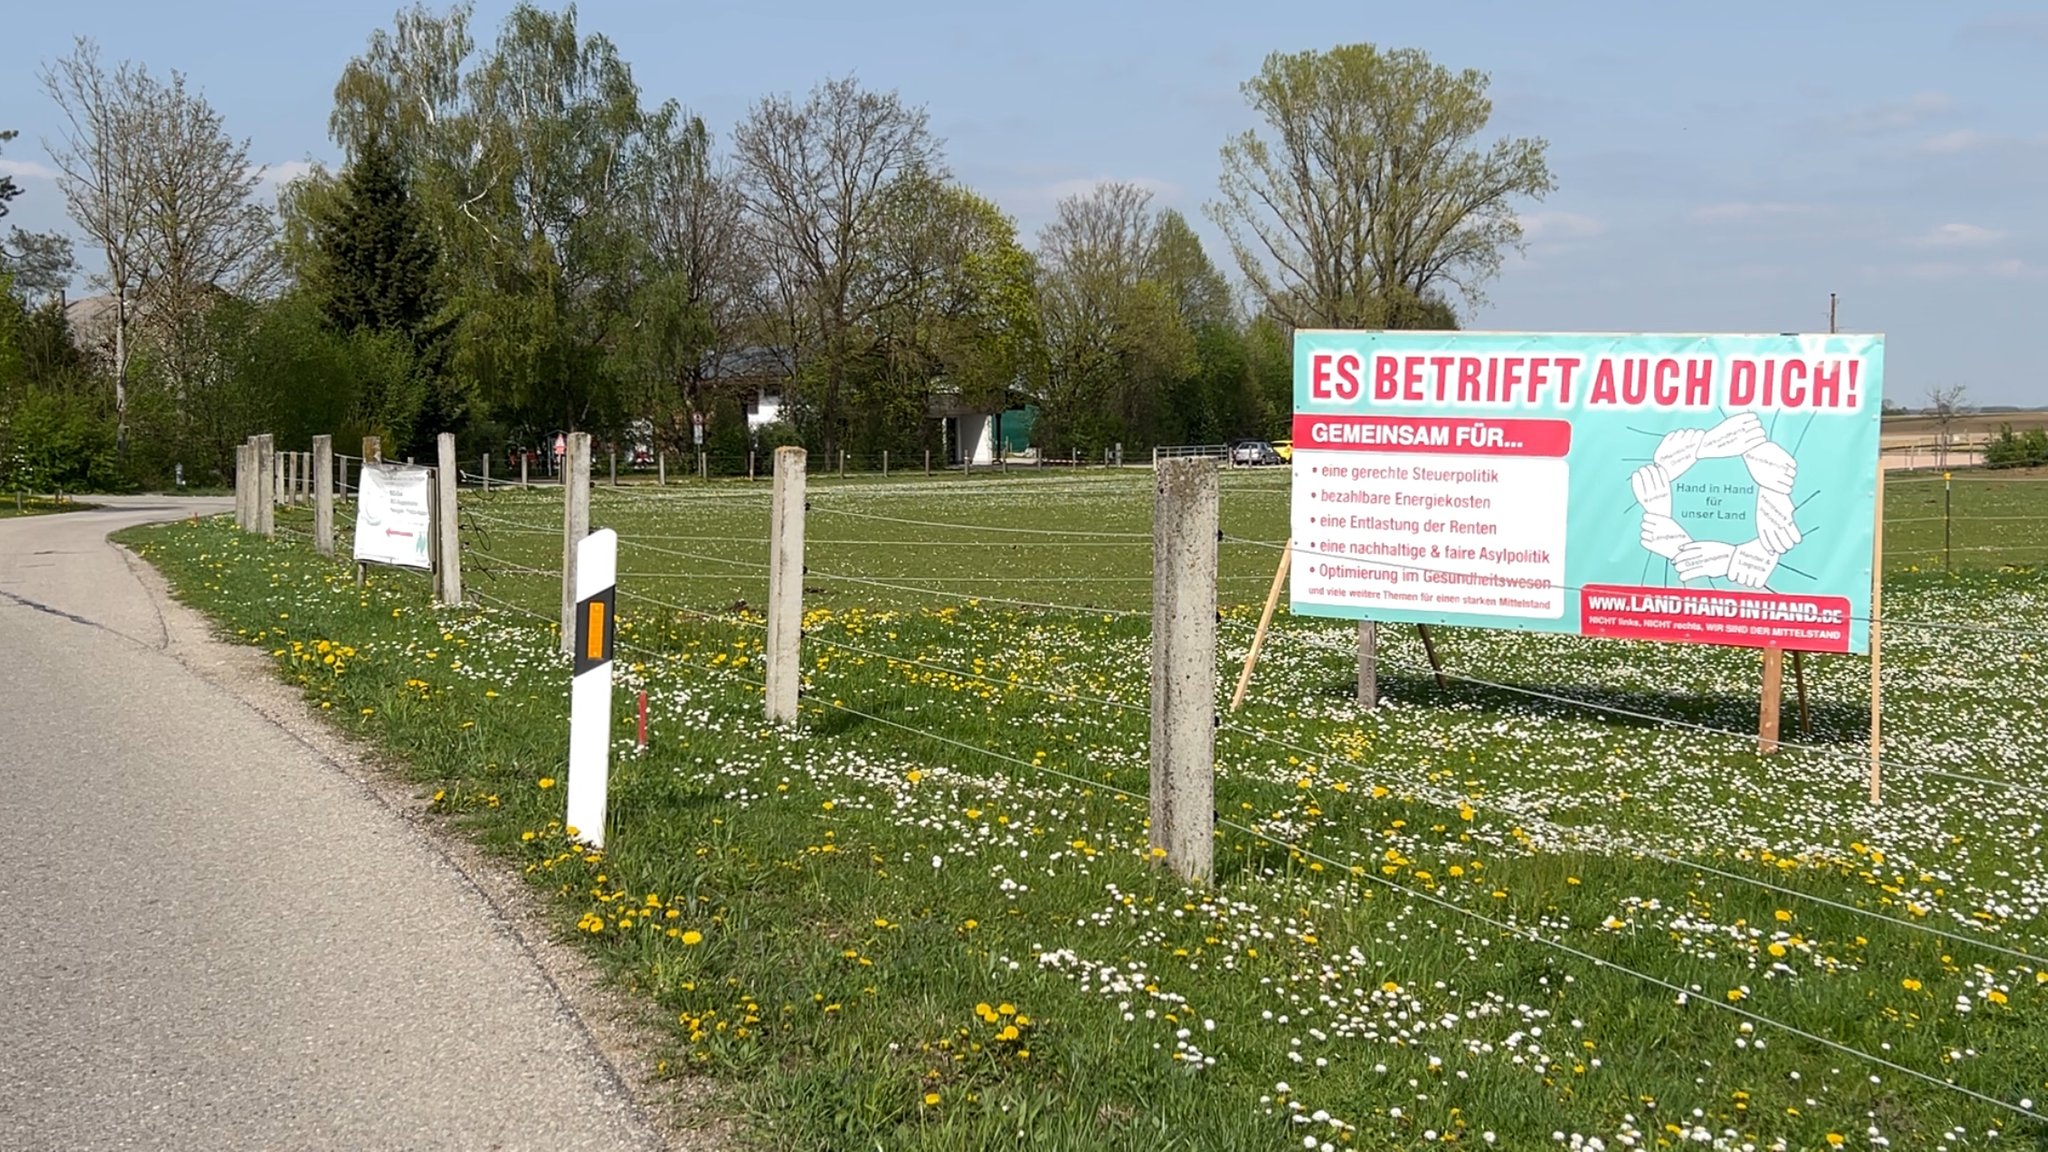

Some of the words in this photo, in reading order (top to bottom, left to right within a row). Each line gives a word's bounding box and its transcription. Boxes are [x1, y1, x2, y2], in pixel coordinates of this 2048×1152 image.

[1313, 355, 1360, 400] ES
[1374, 356, 1580, 404] BETRIFFT
[1590, 358, 1712, 406] AUCH
[1729, 359, 1859, 408] DICH!
[1312, 423, 1450, 446] GEMEINSAM
[1456, 422, 1523, 448] FÜR...
[1322, 466, 1348, 478] eine
[1351, 466, 1408, 480] gerechte
[1412, 467, 1498, 484] Steuerpolitik
[1676, 483, 1706, 493] Hand
[1709, 484, 1720, 493] in
[1723, 484, 1754, 494] Hand
[1321, 489, 1391, 505] bezahlbare
[1395, 492, 1491, 510] Energiekosten
[1706, 496, 1723, 506] für
[1320, 515, 1346, 528] eine
[1350, 516, 1419, 534] Entlastung
[1423, 518, 1445, 533] der
[1450, 520, 1497, 535] Renten
[1681, 510, 1714, 519] unser
[1717, 511, 1746, 520] Land
[1320, 540, 1345, 553] eine
[1350, 542, 1426, 560] nachhaltige
[1430, 545, 1441, 558] &
[1445, 545, 1475, 560] faire
[1479, 547, 1550, 564] Asylpolitik
[1319, 563, 1398, 584] Optimierung
[1402, 568, 1419, 582] im
[1309, 587, 1324, 595] und
[1327, 588, 1346, 597] viele
[1350, 589, 1381, 599] weitere
[1383, 590, 1418, 601] Themen
[1421, 592, 1433, 601] für
[1436, 594, 1460, 603] einen
[1463, 595, 1496, 606] starken
[1499, 598, 1551, 609] Mittelstand
[1588, 616, 1616, 625] NICHT
[1643, 619, 1671, 629] NICHT
[1706, 622, 1724, 632] WIR
[1725, 624, 1748, 634] SIND
[1750, 626, 1770, 635] DER
[1772, 628, 1841, 640] MITTELSTAND
